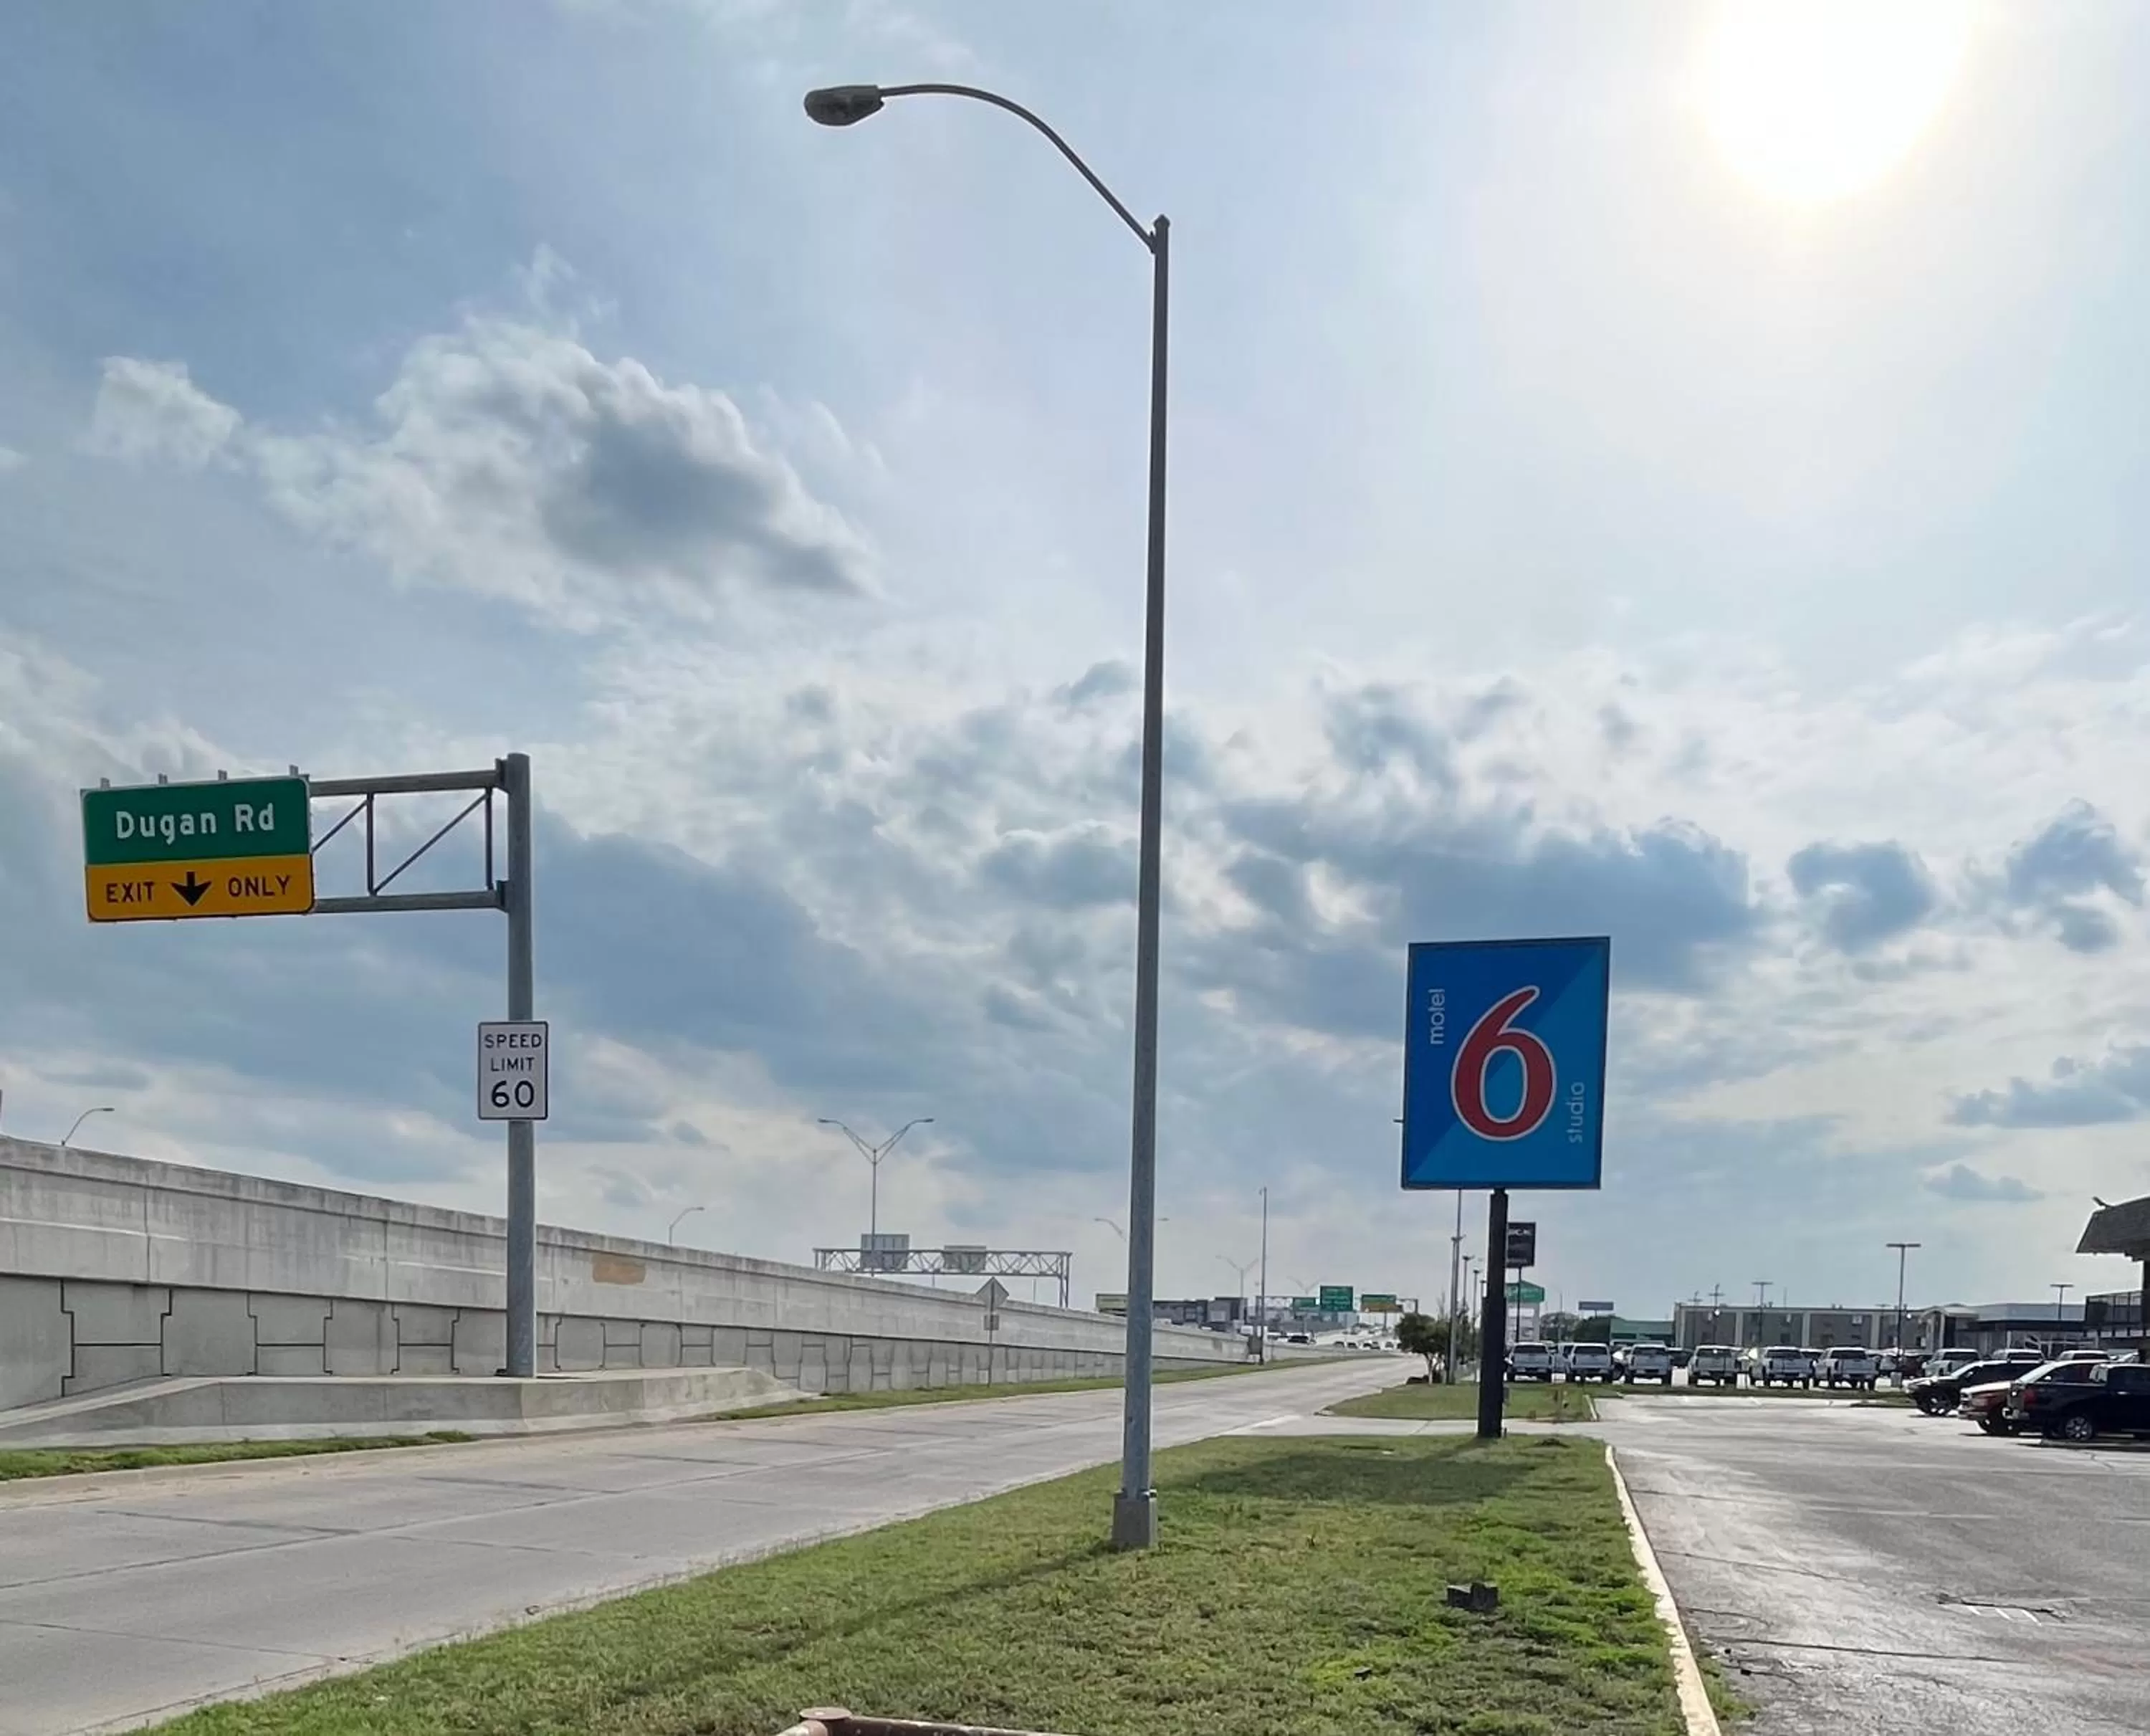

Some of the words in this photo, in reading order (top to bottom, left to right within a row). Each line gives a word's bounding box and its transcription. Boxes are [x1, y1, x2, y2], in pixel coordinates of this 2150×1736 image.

[116, 811, 216, 844] Dugan
[234, 803, 274, 831] Rd
[106, 882, 155, 903] EXIT
[229, 875, 290, 897] ONLY
[1428, 988, 1446, 1044] motel
[484, 1034, 542, 1048] SPEED
[491, 1057, 534, 1071] LIMIT
[1451, 985, 1557, 1142] 6
[492, 1080, 534, 1107] 60
[1565, 1082, 1585, 1143] studio
